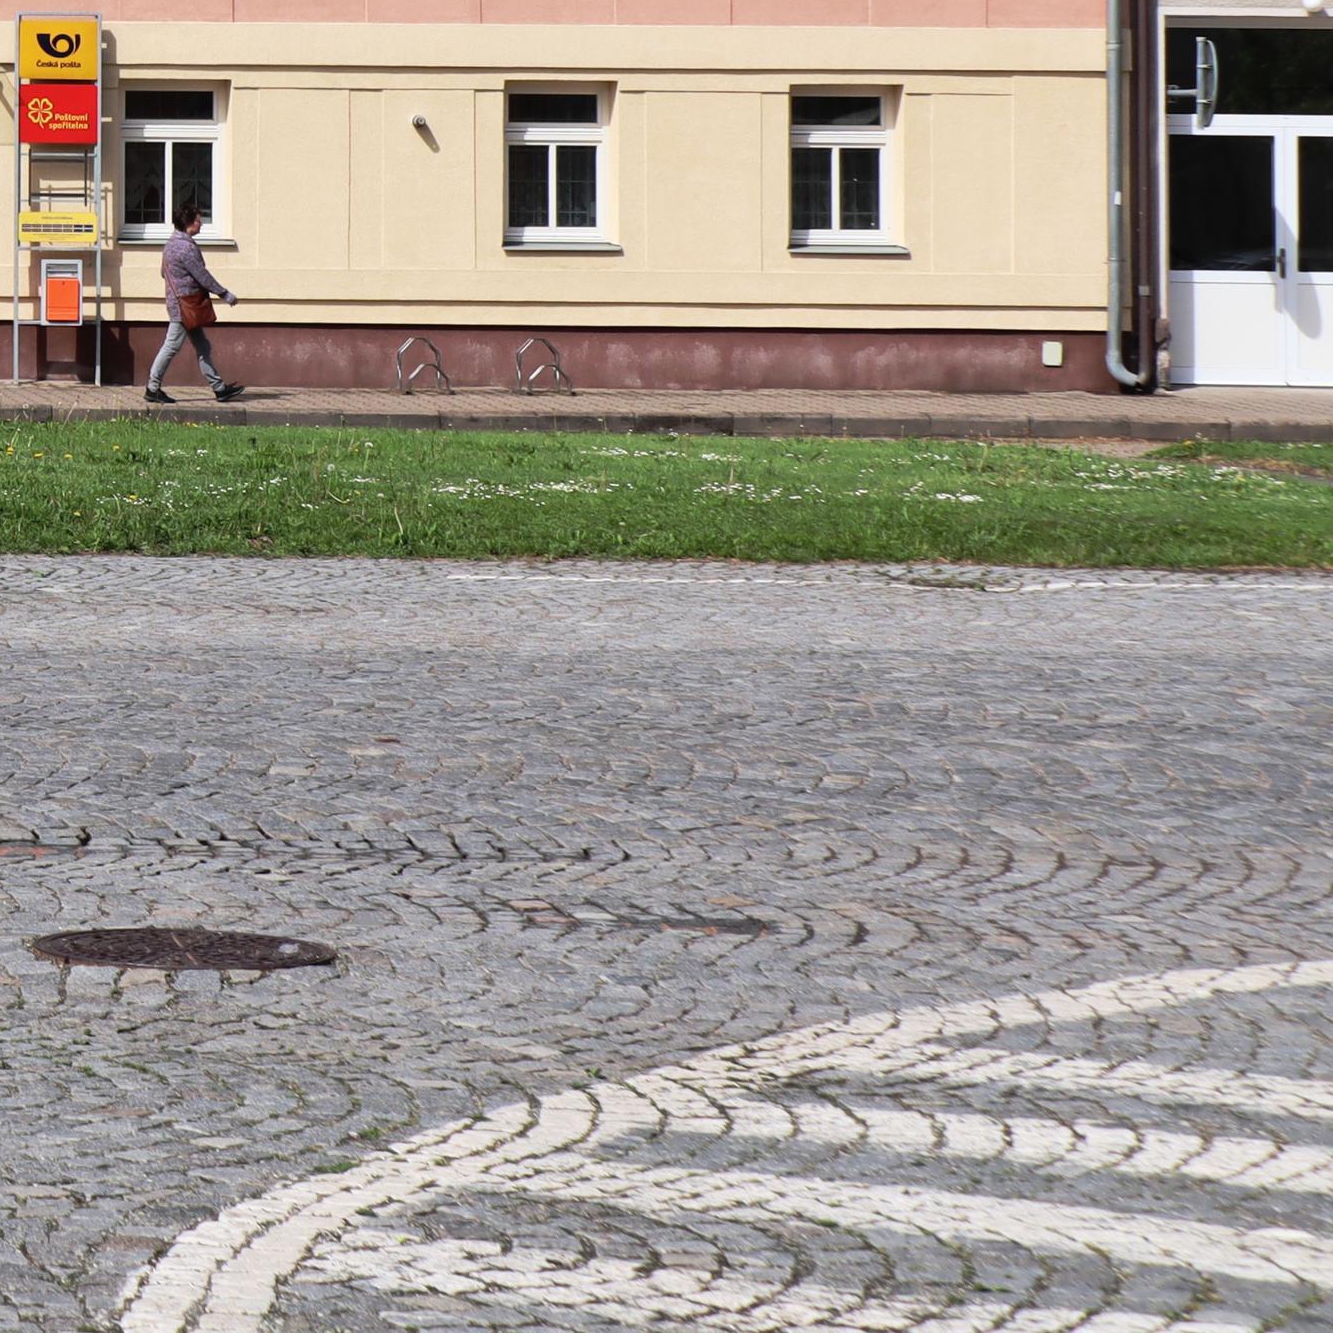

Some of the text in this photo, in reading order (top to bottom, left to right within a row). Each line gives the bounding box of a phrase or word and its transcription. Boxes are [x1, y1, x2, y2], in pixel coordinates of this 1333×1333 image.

[36, 59, 81, 69] Česká pošta
[54, 113, 88, 122] Poštovní
[49, 121, 88, 130] spořitelna
